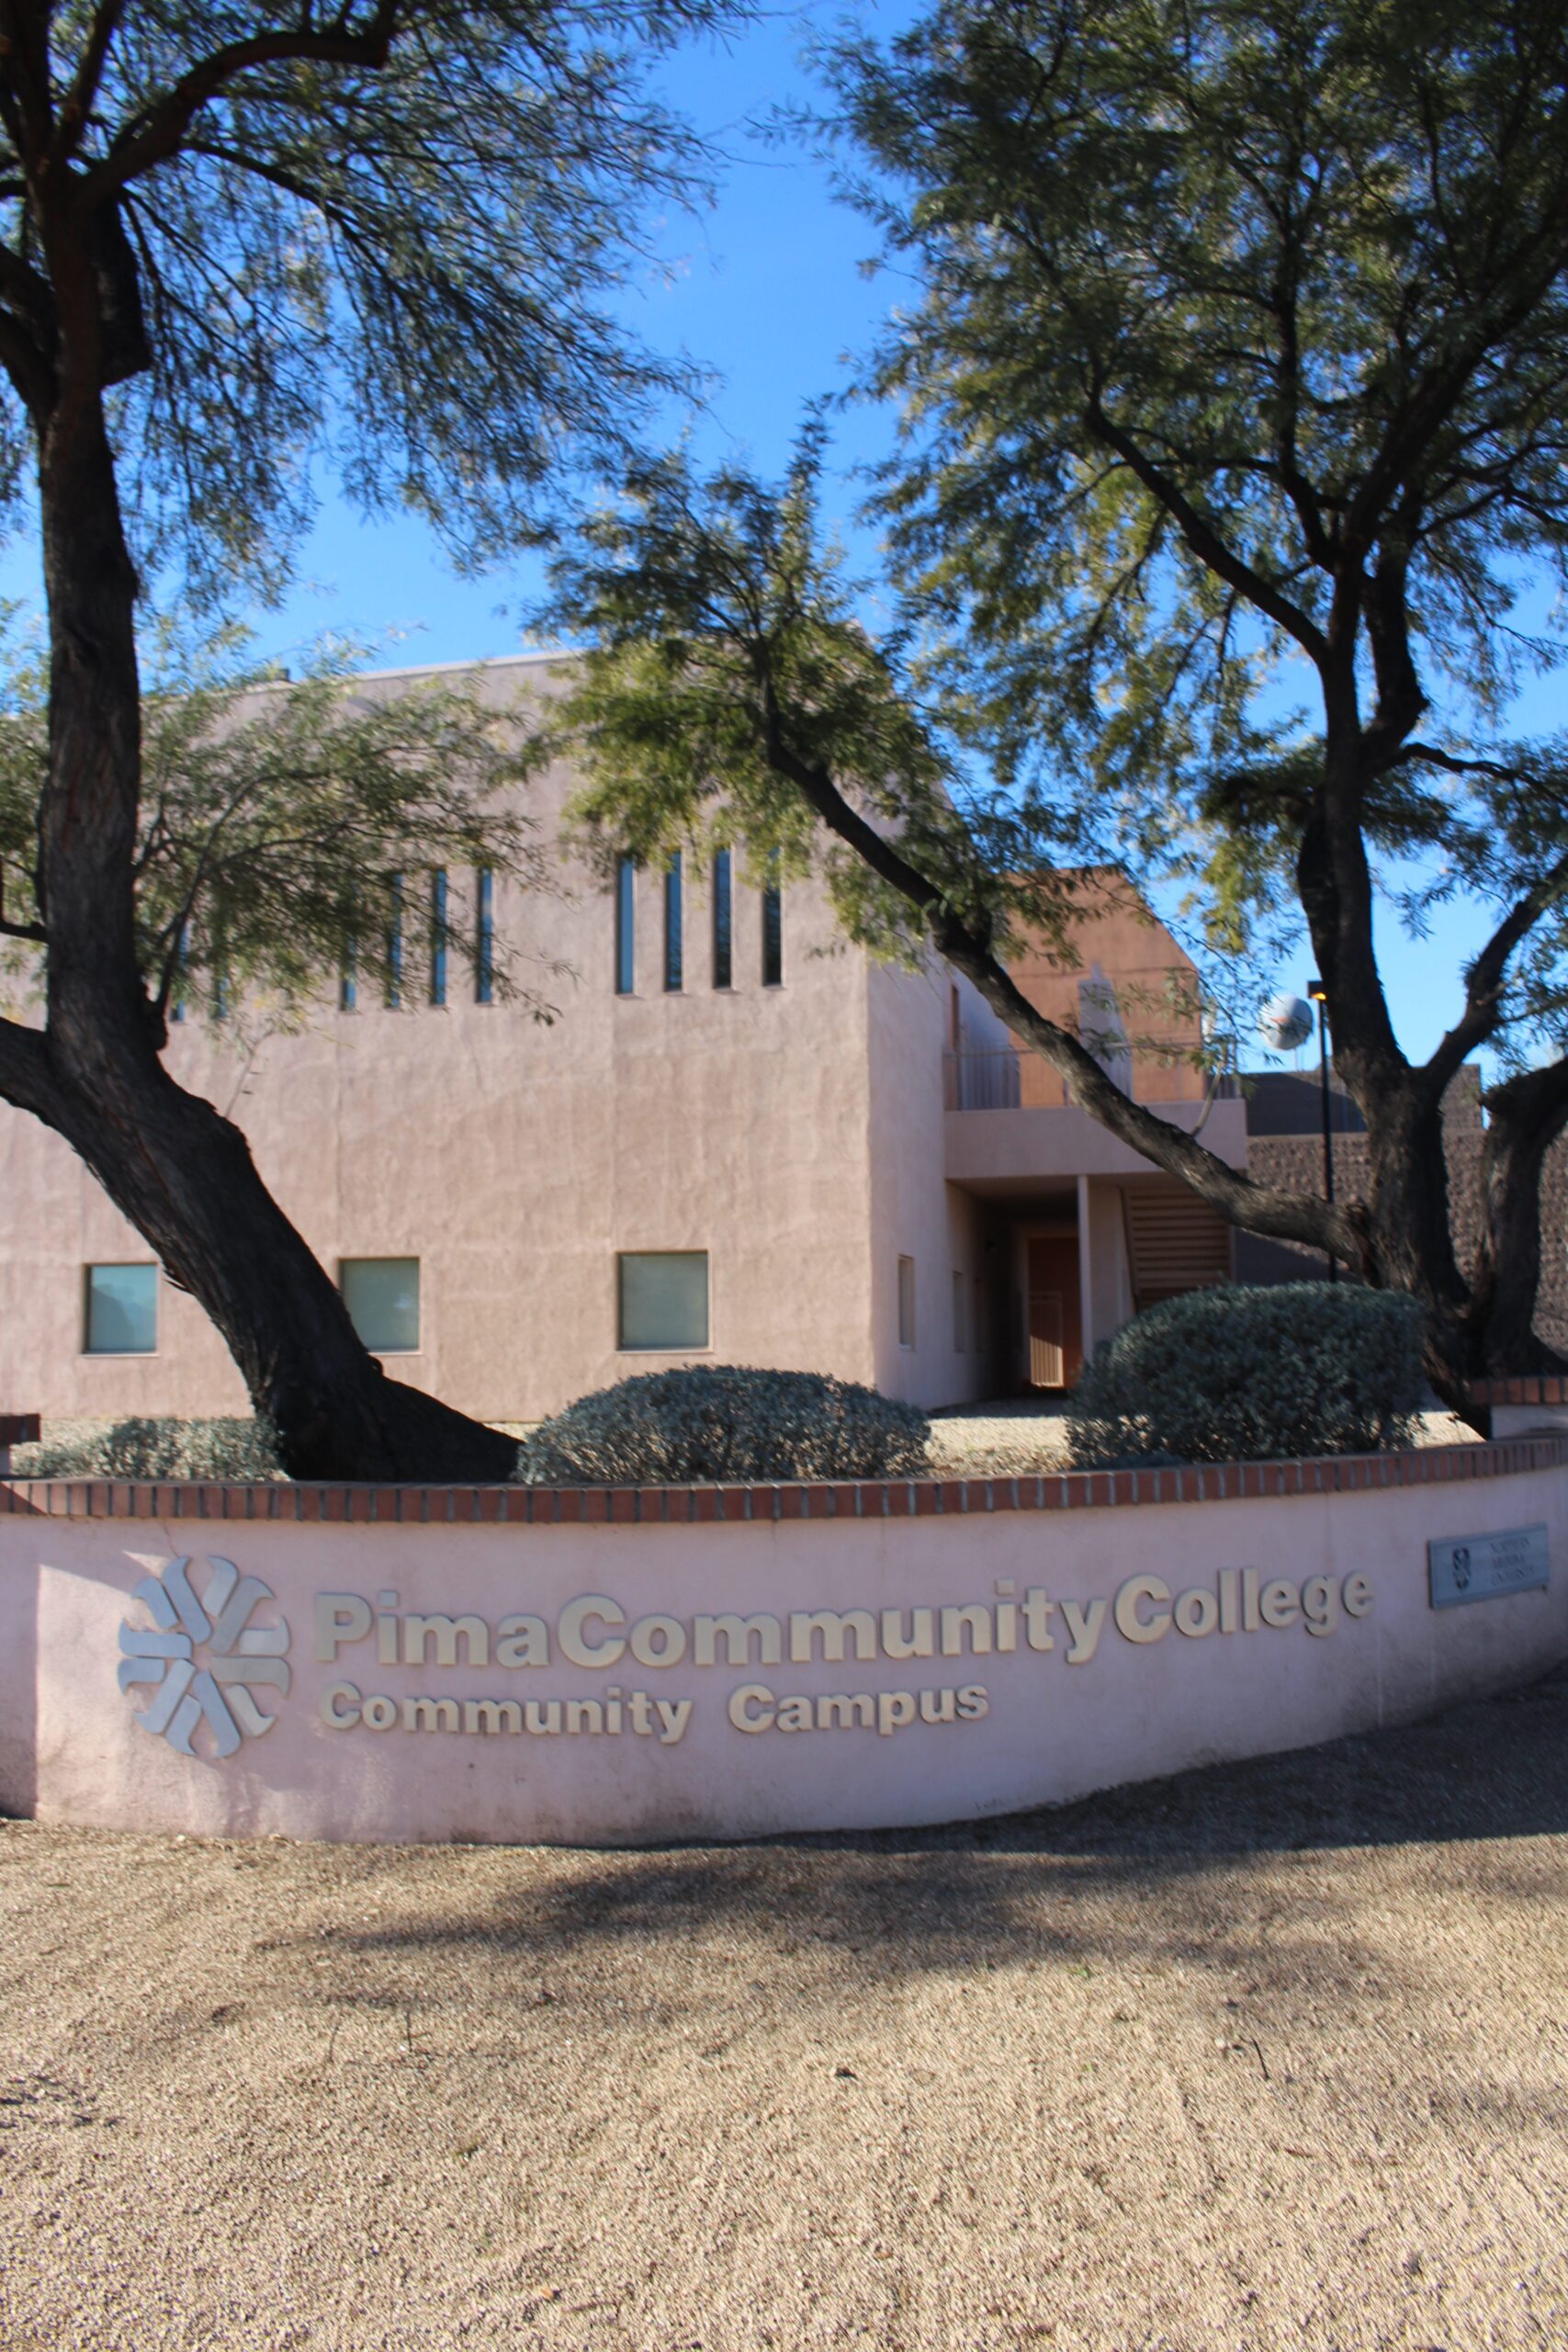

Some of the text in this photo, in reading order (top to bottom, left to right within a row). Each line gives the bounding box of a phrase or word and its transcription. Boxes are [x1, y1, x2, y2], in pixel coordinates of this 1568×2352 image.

[315, 1566, 1375, 1668] Pima Community College
[320, 1680, 989, 1745] Community Campus
